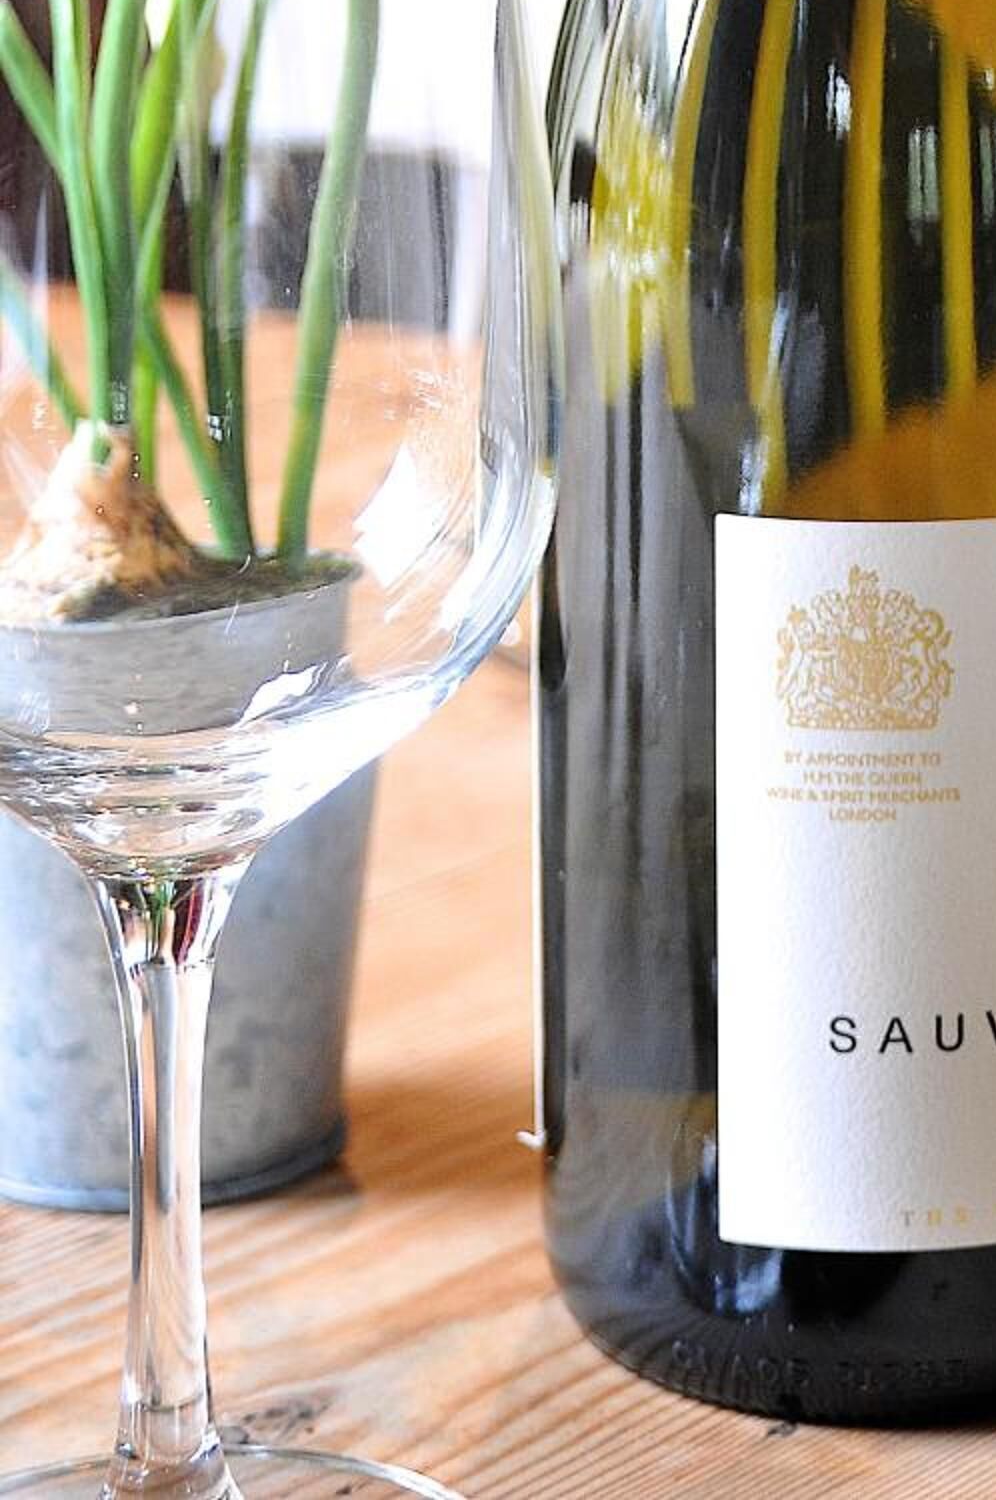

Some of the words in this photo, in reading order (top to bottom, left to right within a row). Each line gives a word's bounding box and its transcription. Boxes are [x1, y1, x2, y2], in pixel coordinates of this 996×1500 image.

[836, 771, 865, 785] THE
[868, 771, 923, 786] QUEEN
[829, 808, 898, 822] LONDON
